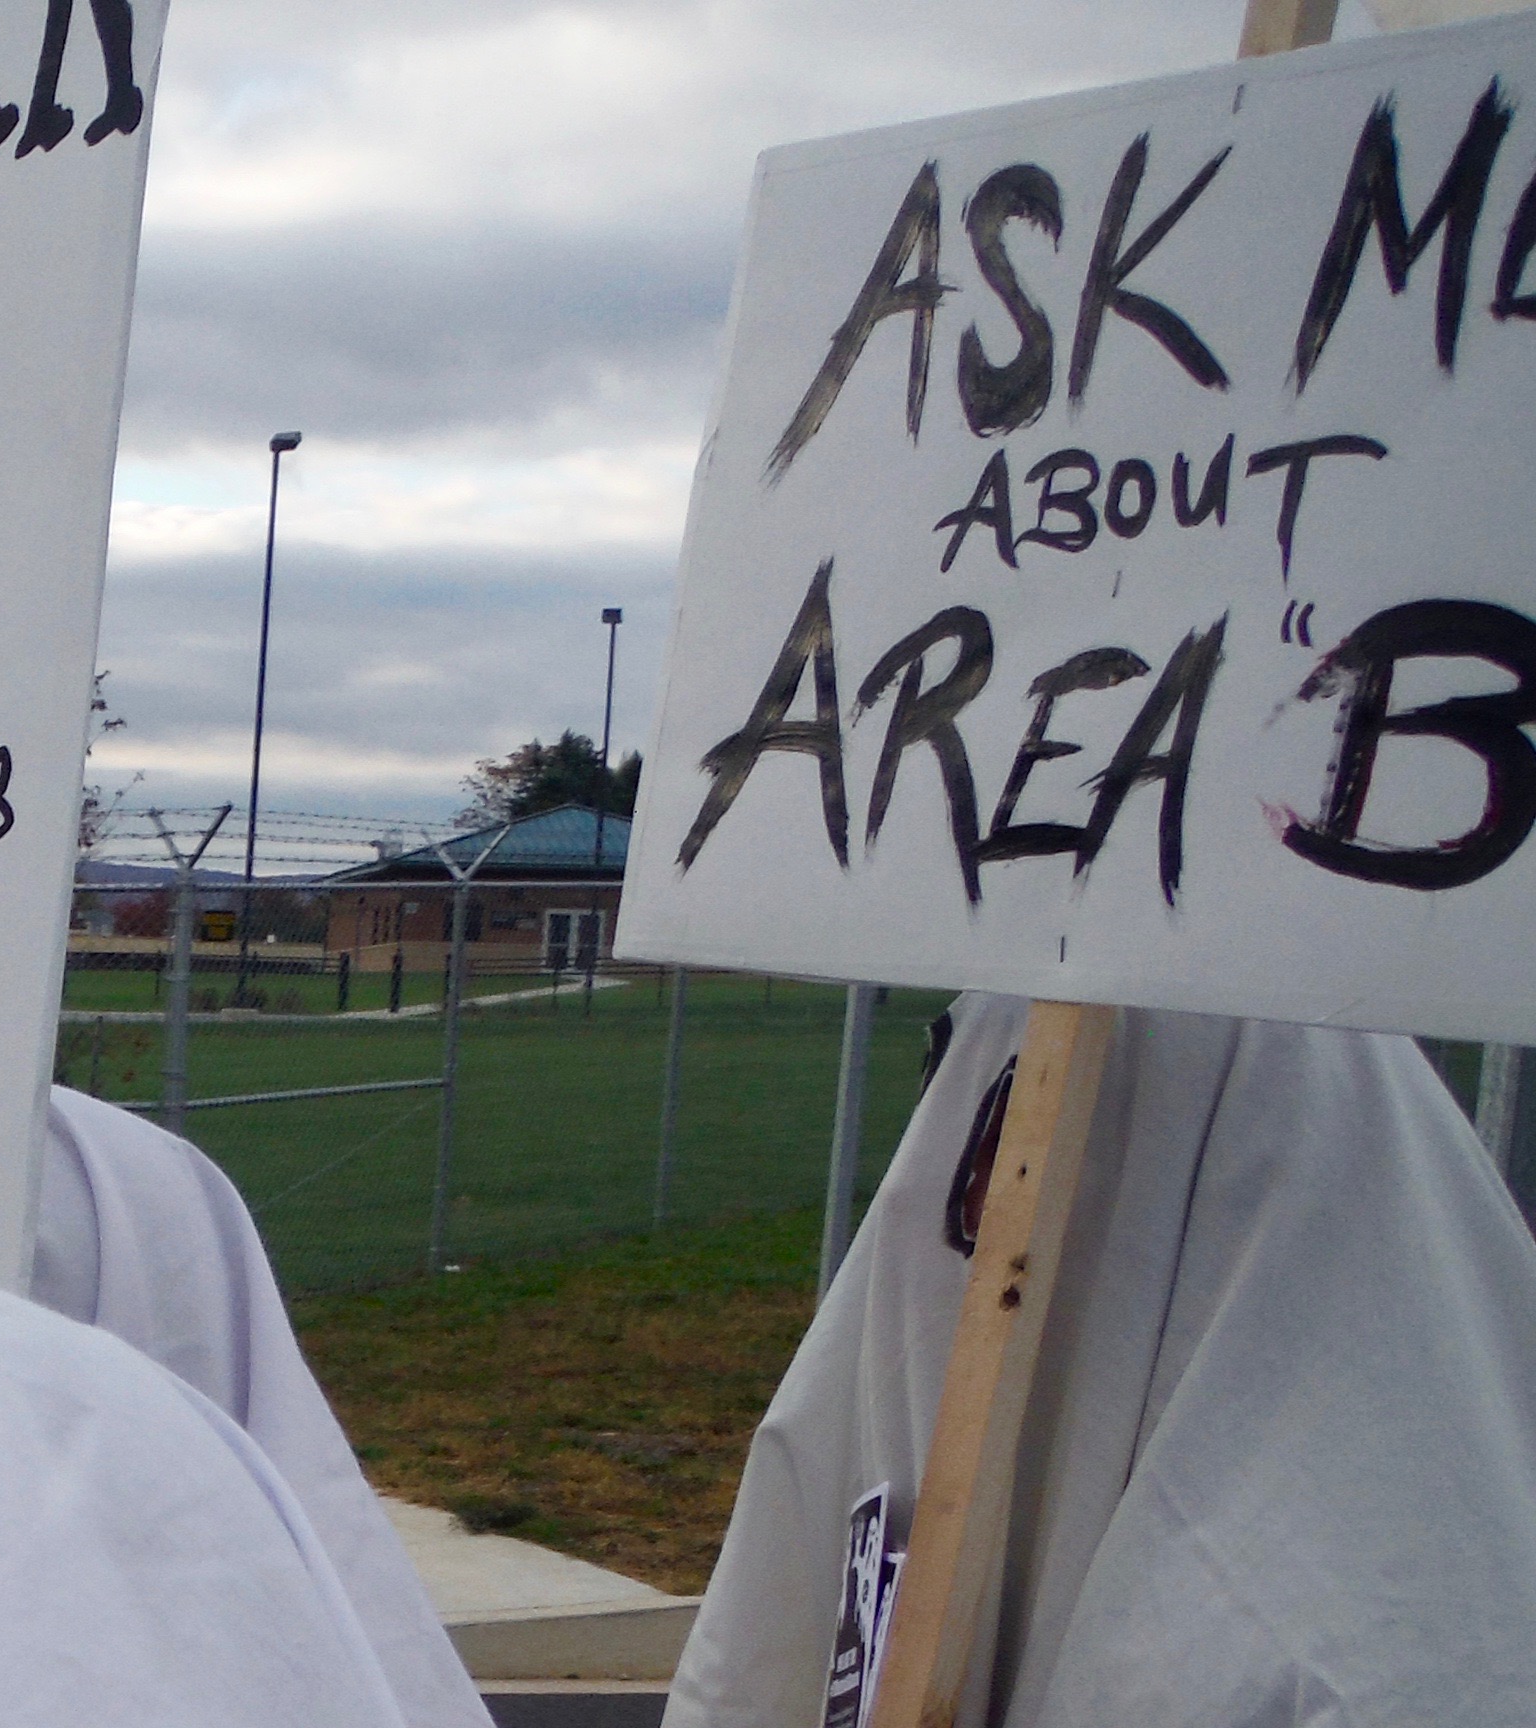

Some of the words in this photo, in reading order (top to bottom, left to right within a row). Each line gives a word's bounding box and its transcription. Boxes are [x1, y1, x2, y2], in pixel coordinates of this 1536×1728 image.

[760, 130, 1234, 488] ASK
[933, 433, 1389, 587] ABOUT
[675, 555, 1229, 912] AREA
